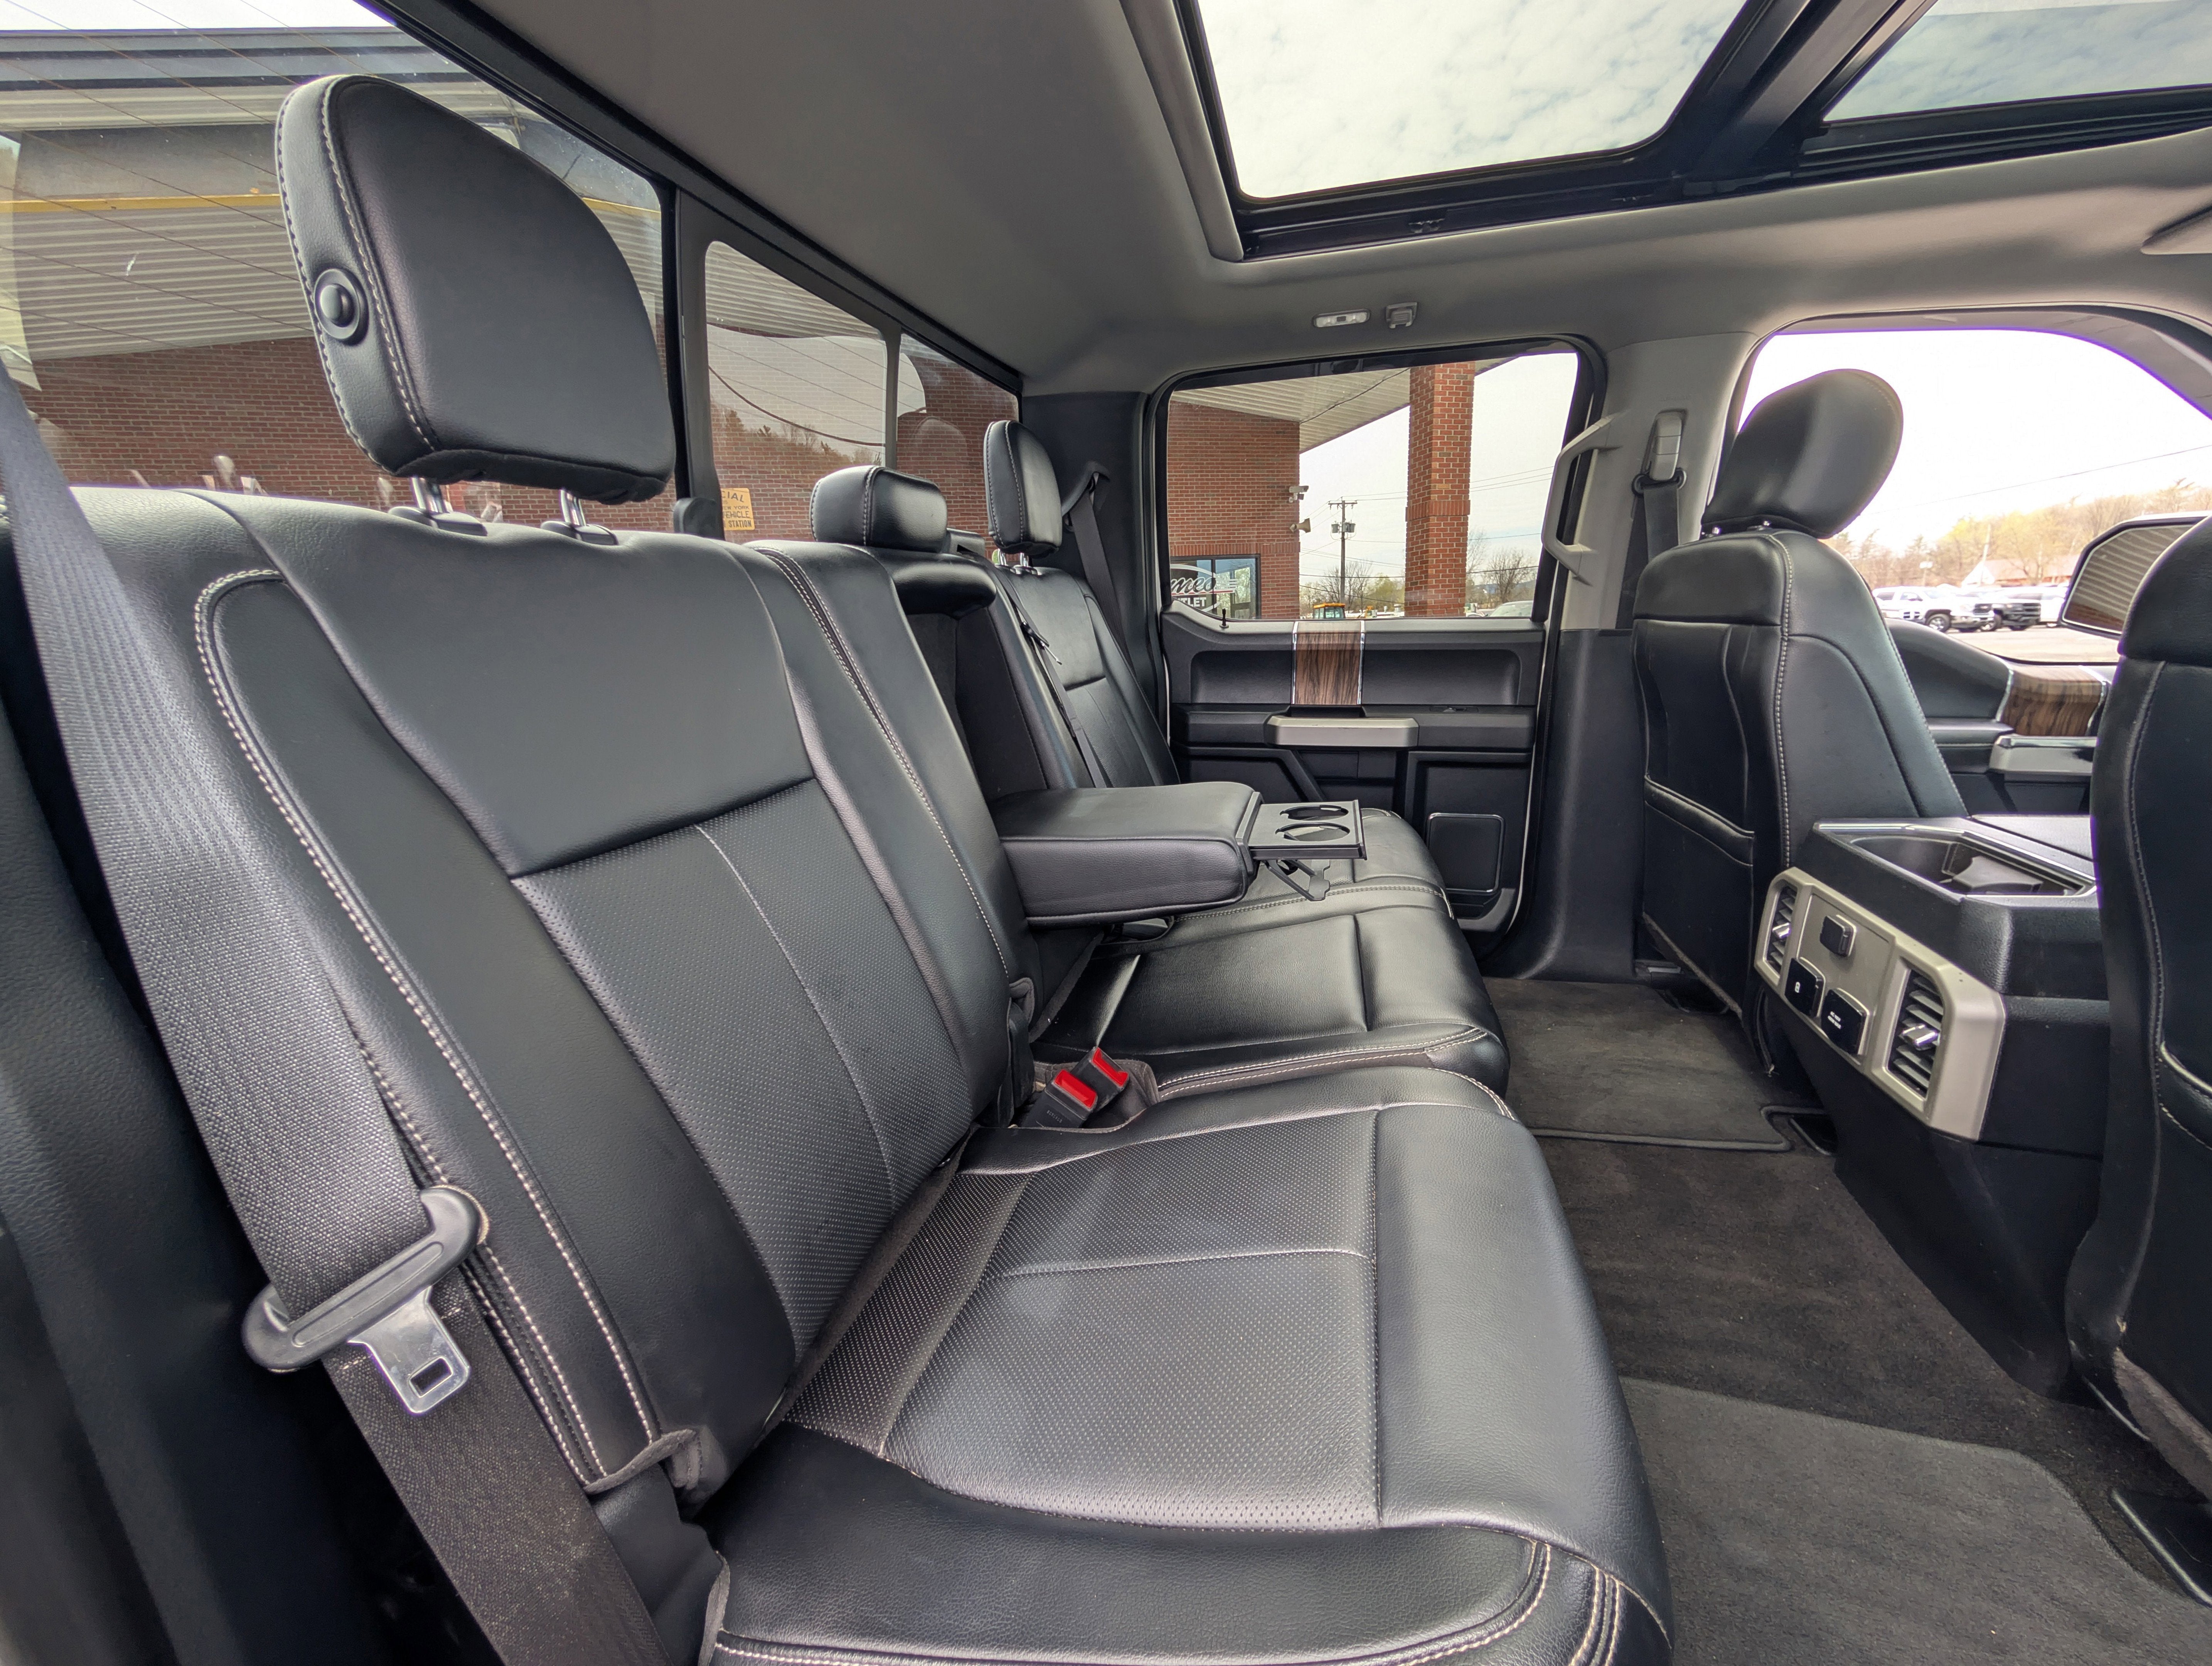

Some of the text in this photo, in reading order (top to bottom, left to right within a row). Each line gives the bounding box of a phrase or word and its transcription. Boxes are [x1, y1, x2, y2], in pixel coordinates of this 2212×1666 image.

[722, 491, 744, 502] CIAL
[728, 520, 752, 528] STATION
[1171, 577, 1216, 594] meo
[1178, 597, 1207, 607] TLET
